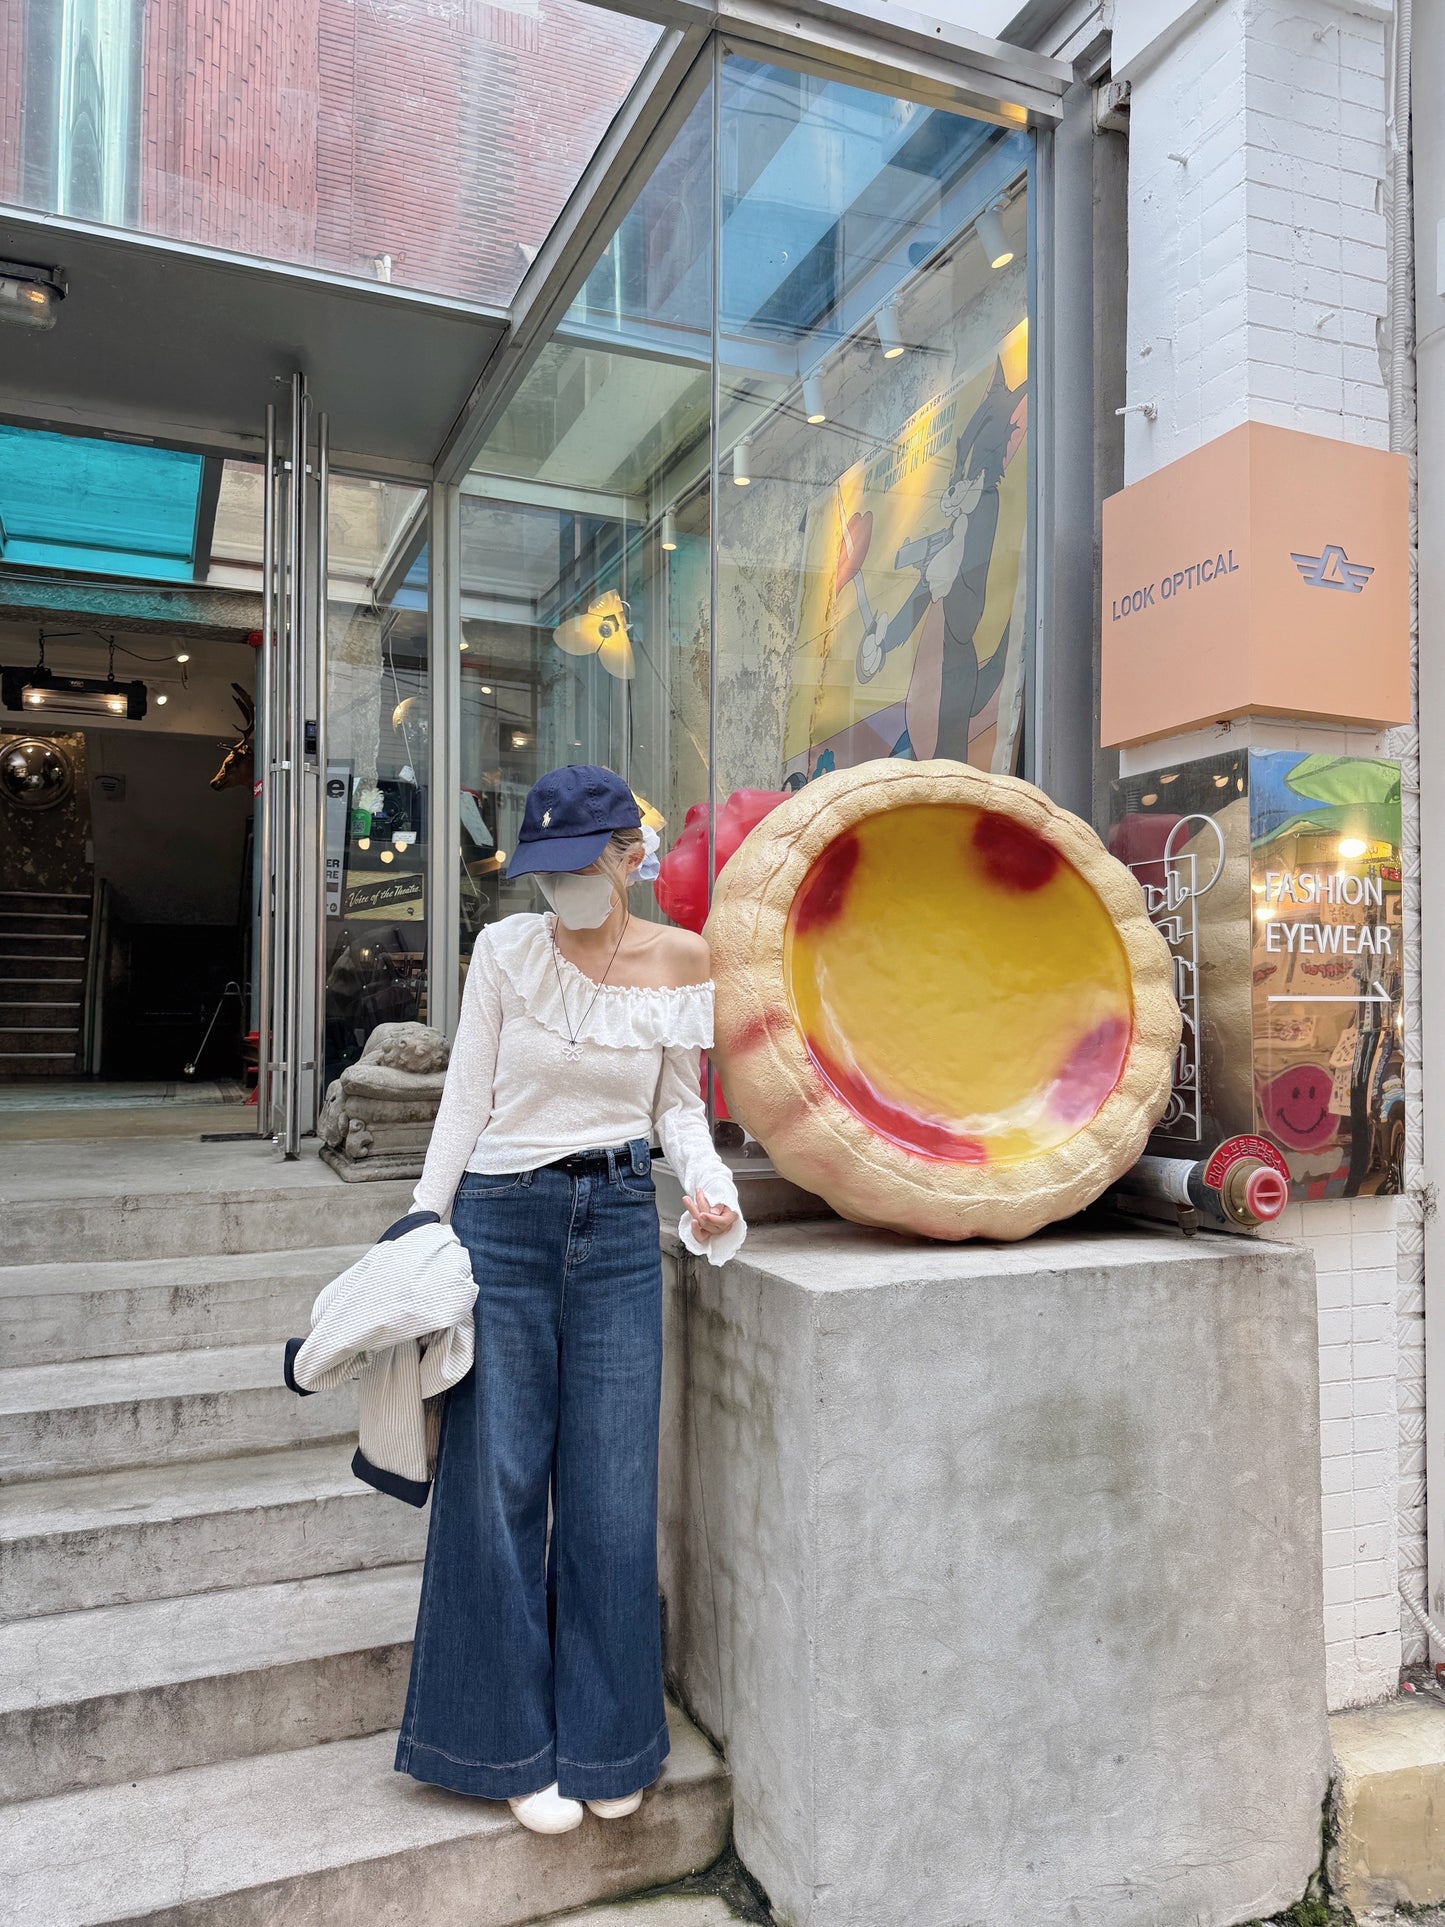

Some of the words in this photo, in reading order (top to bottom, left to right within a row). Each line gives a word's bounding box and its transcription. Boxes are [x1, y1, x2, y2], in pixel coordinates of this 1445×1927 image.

[863, 468, 873, 494] 12
[1112, 583, 1155, 621] LOOK
[1161, 550, 1239, 599] OPTICAL
[349, 890, 369, 907] Voice
[370, 891, 381, 905] of
[381, 888, 394, 899] the
[1265, 872, 1383, 906] FASHION
[1266, 922, 1392, 955] EYEWEAR
